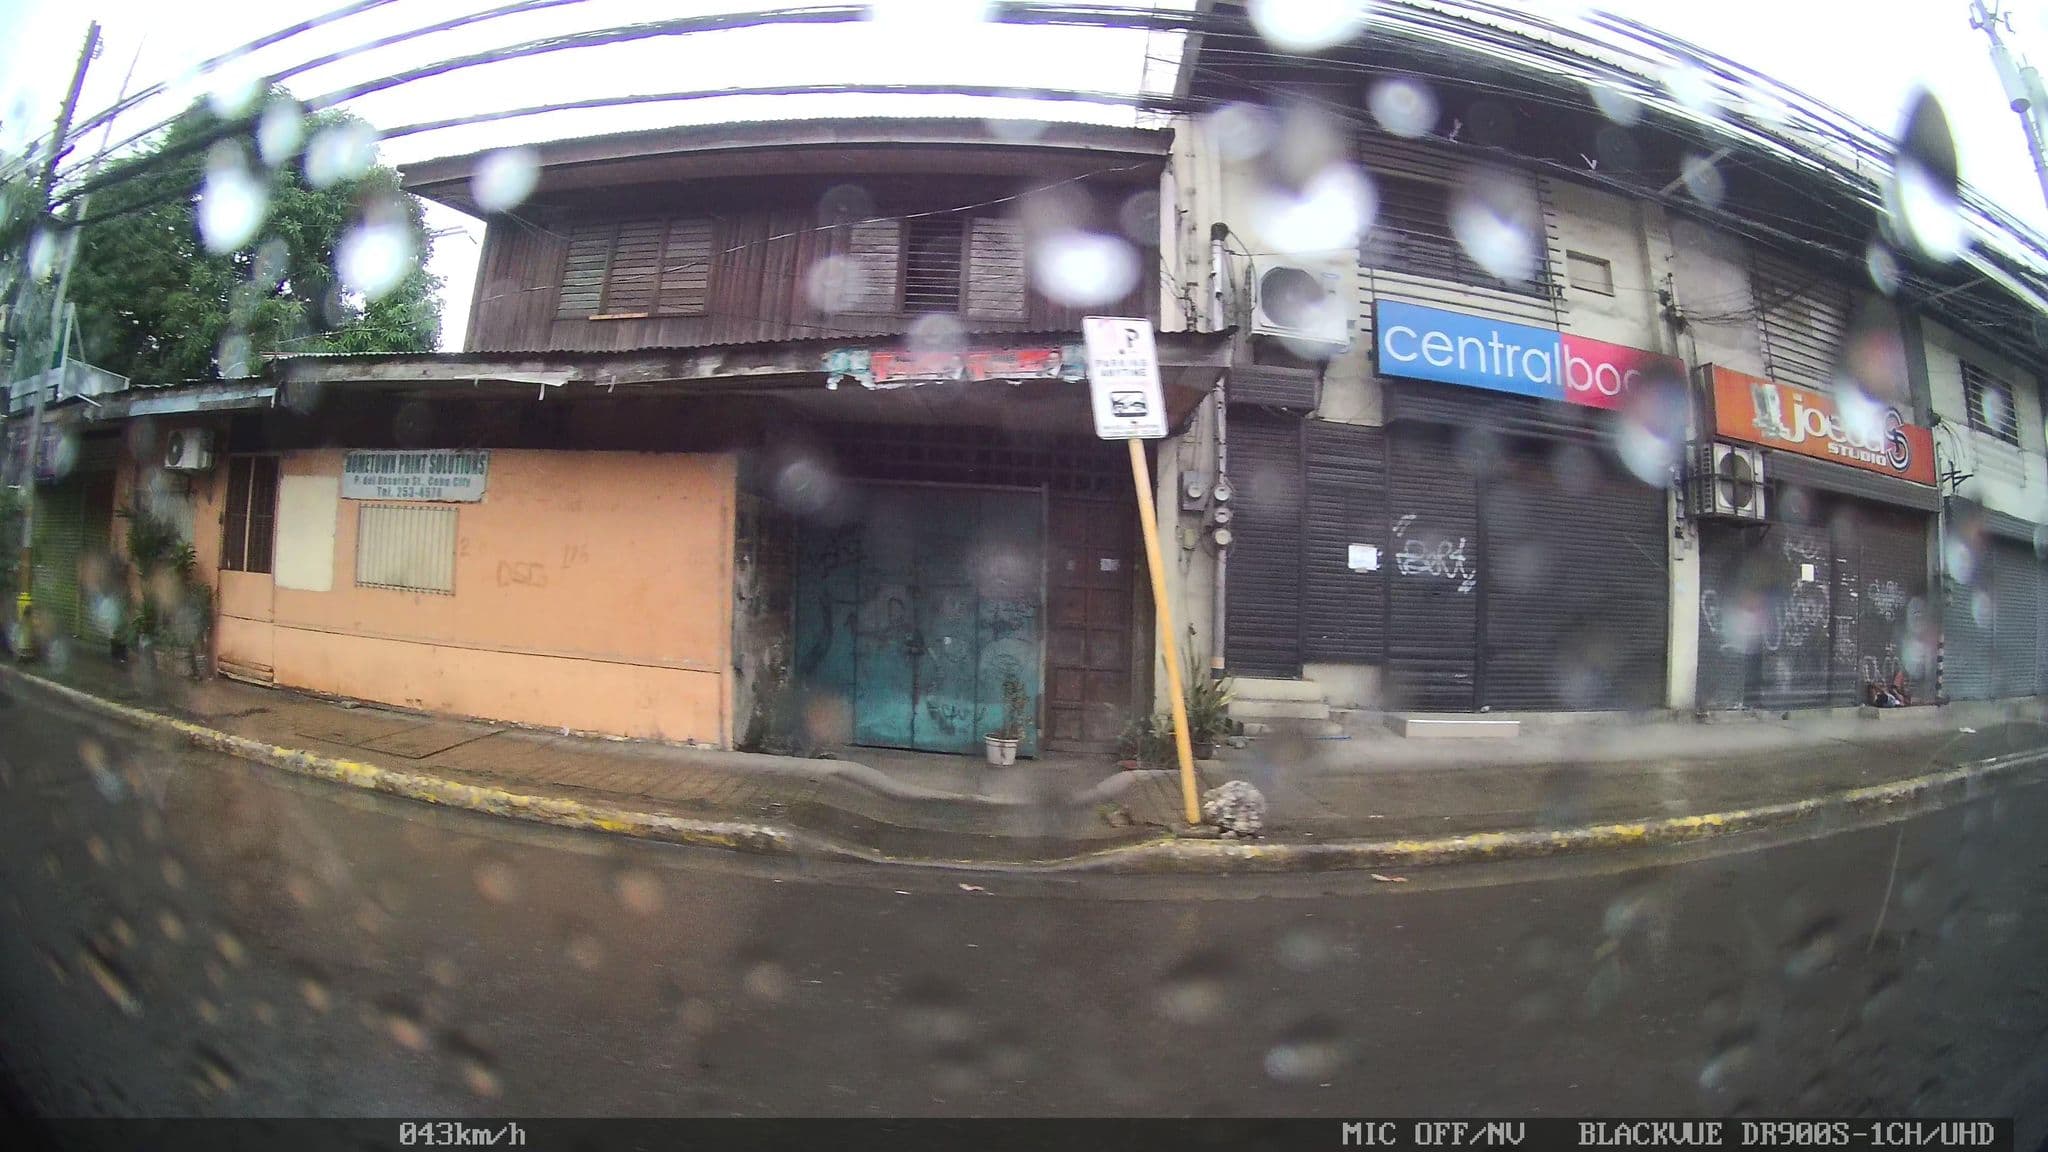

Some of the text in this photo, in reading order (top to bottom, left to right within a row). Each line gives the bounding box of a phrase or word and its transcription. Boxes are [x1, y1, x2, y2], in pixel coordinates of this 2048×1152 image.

[345, 454, 486, 475] HOMETOWN PRINT SOLUTIONS
[1827, 442, 1887, 466] STUDIO
[453, 477, 471, 488] City
